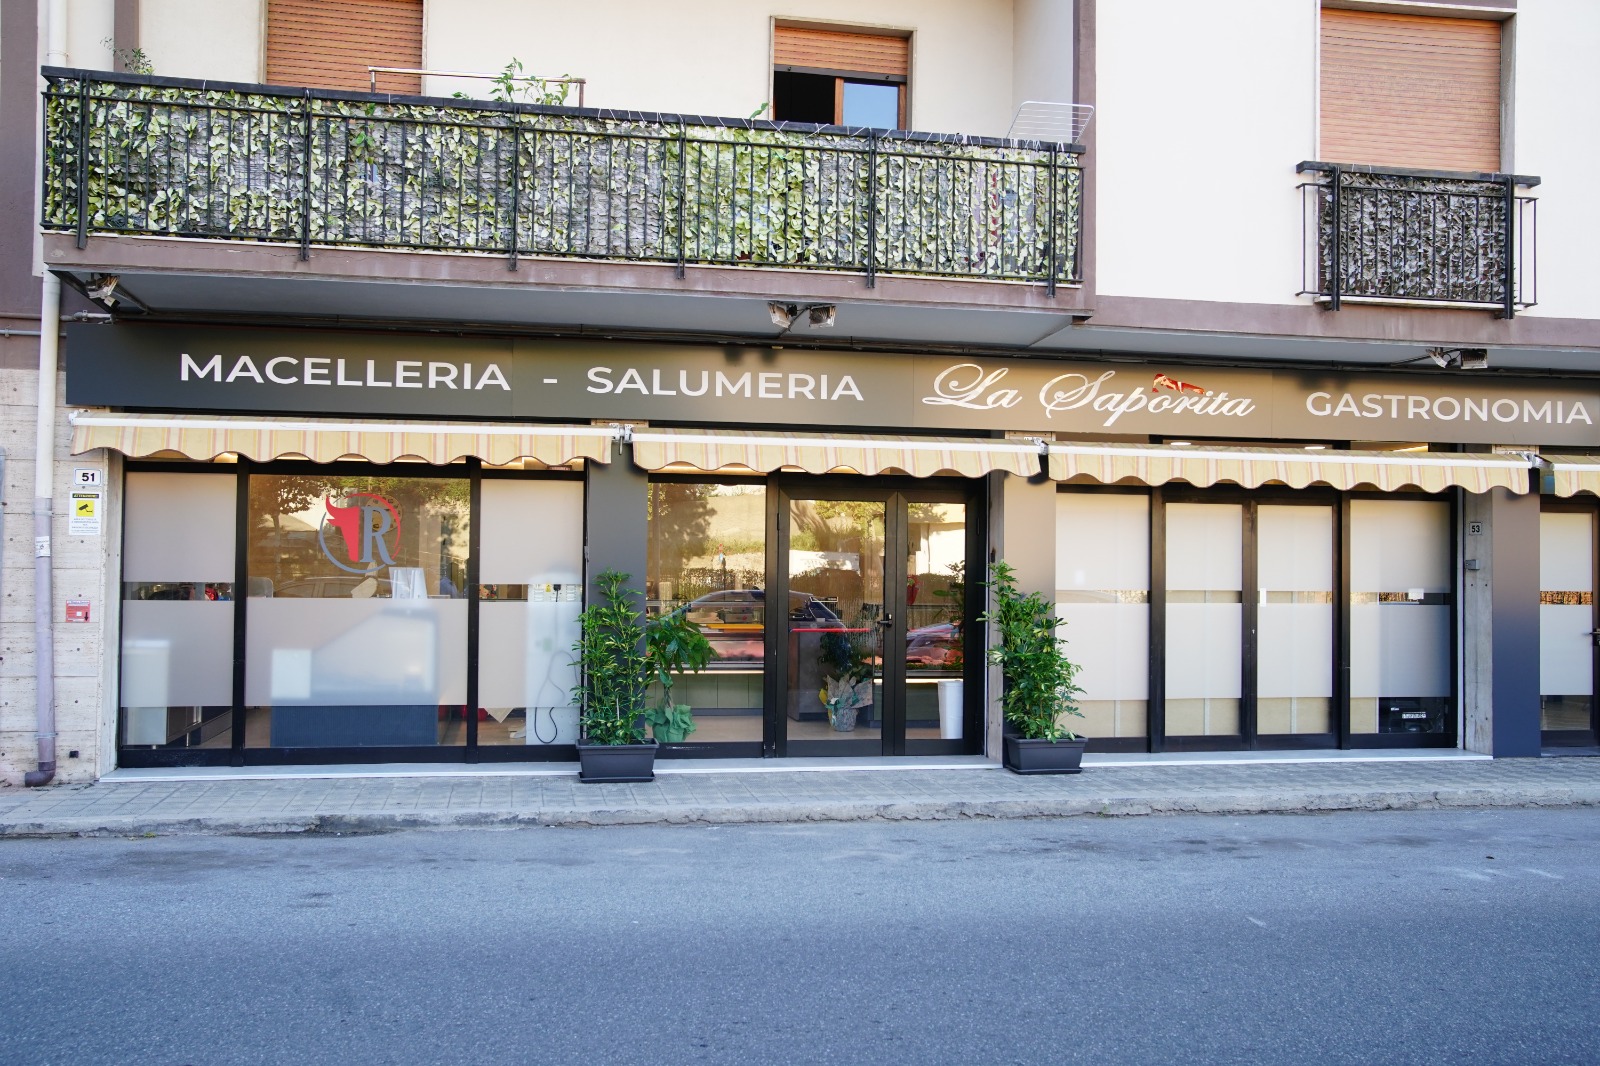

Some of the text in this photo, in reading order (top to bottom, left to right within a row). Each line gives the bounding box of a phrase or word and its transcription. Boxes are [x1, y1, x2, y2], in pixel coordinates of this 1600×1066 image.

[180, 353, 512, 391] MACELLERIA
[586, 366, 865, 401] SALUMERIA
[922, 363, 1256, 427] La Saporita
[1305, 391, 1593, 425] GASTRONOMIA
[81, 472, 95, 482] 51
[360, 506, 397, 565] R
[1471, 525, 1480, 533] 53
